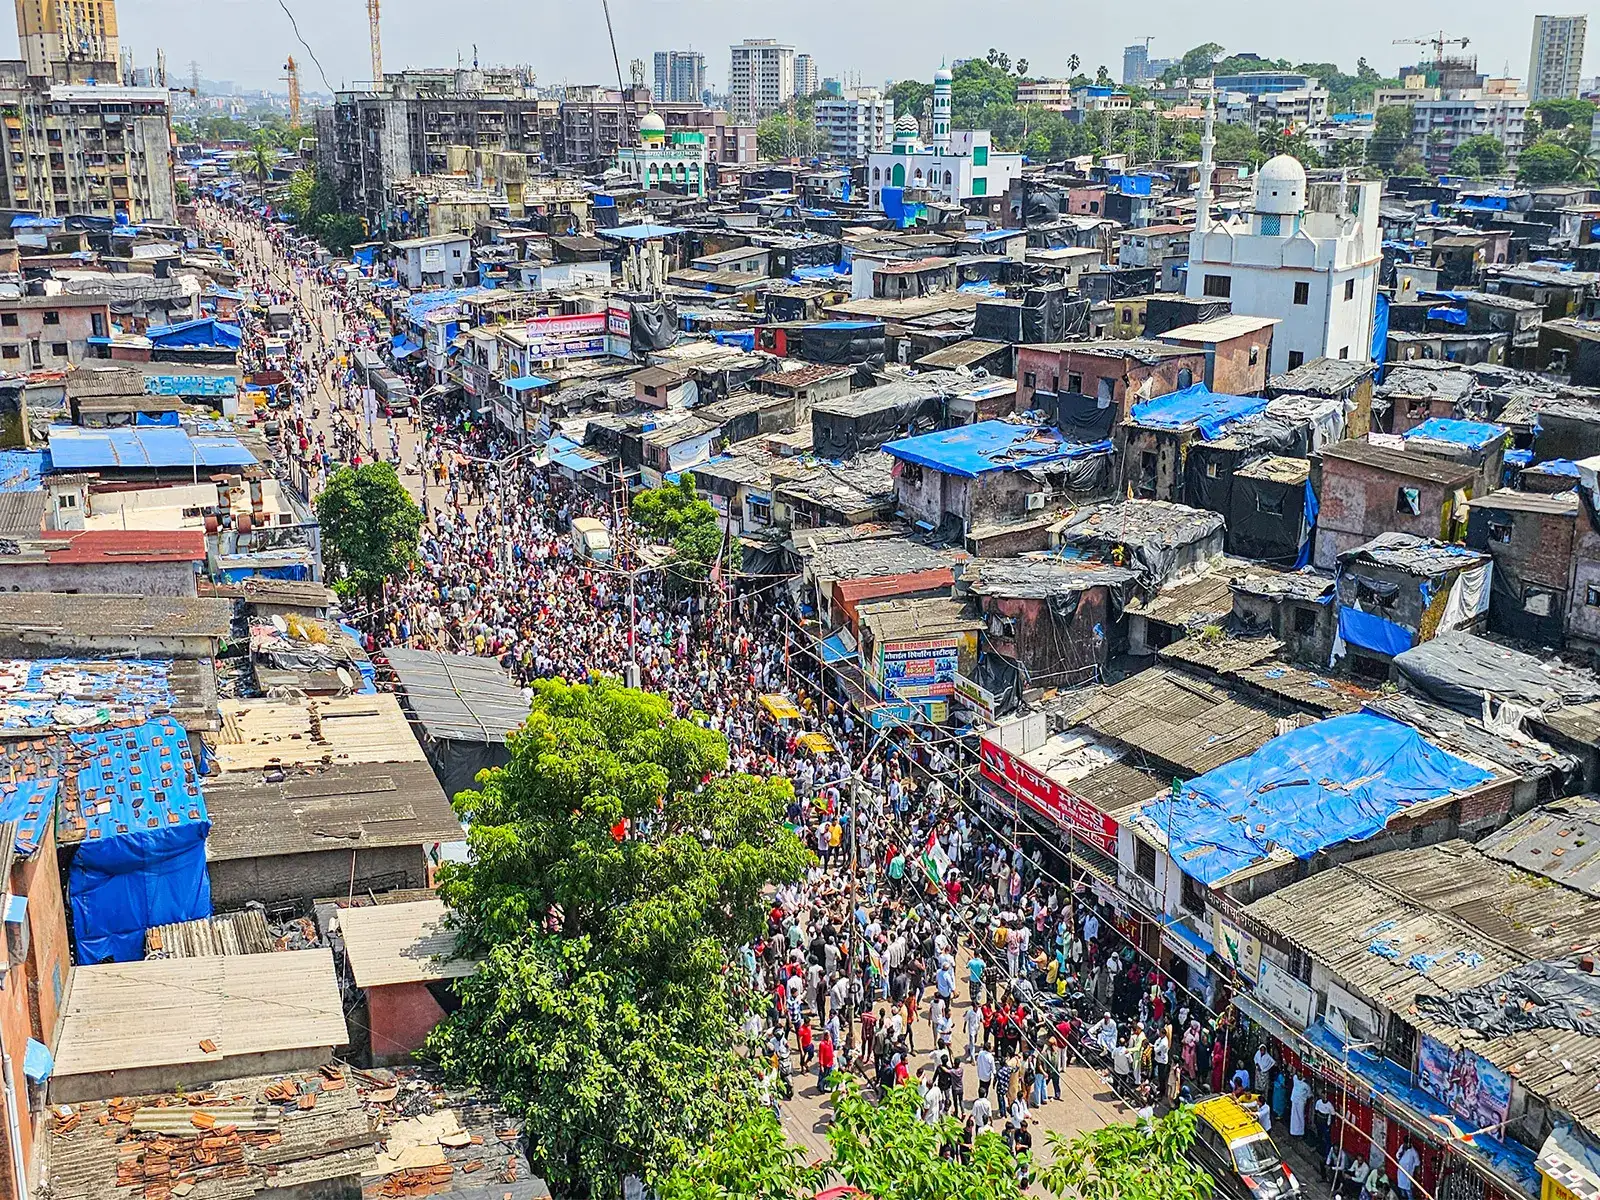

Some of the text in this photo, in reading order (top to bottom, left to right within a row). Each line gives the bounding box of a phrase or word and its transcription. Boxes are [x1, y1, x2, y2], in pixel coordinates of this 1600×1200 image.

[884, 638, 957, 651] MOBILE REPAIRING INSTITUTE
